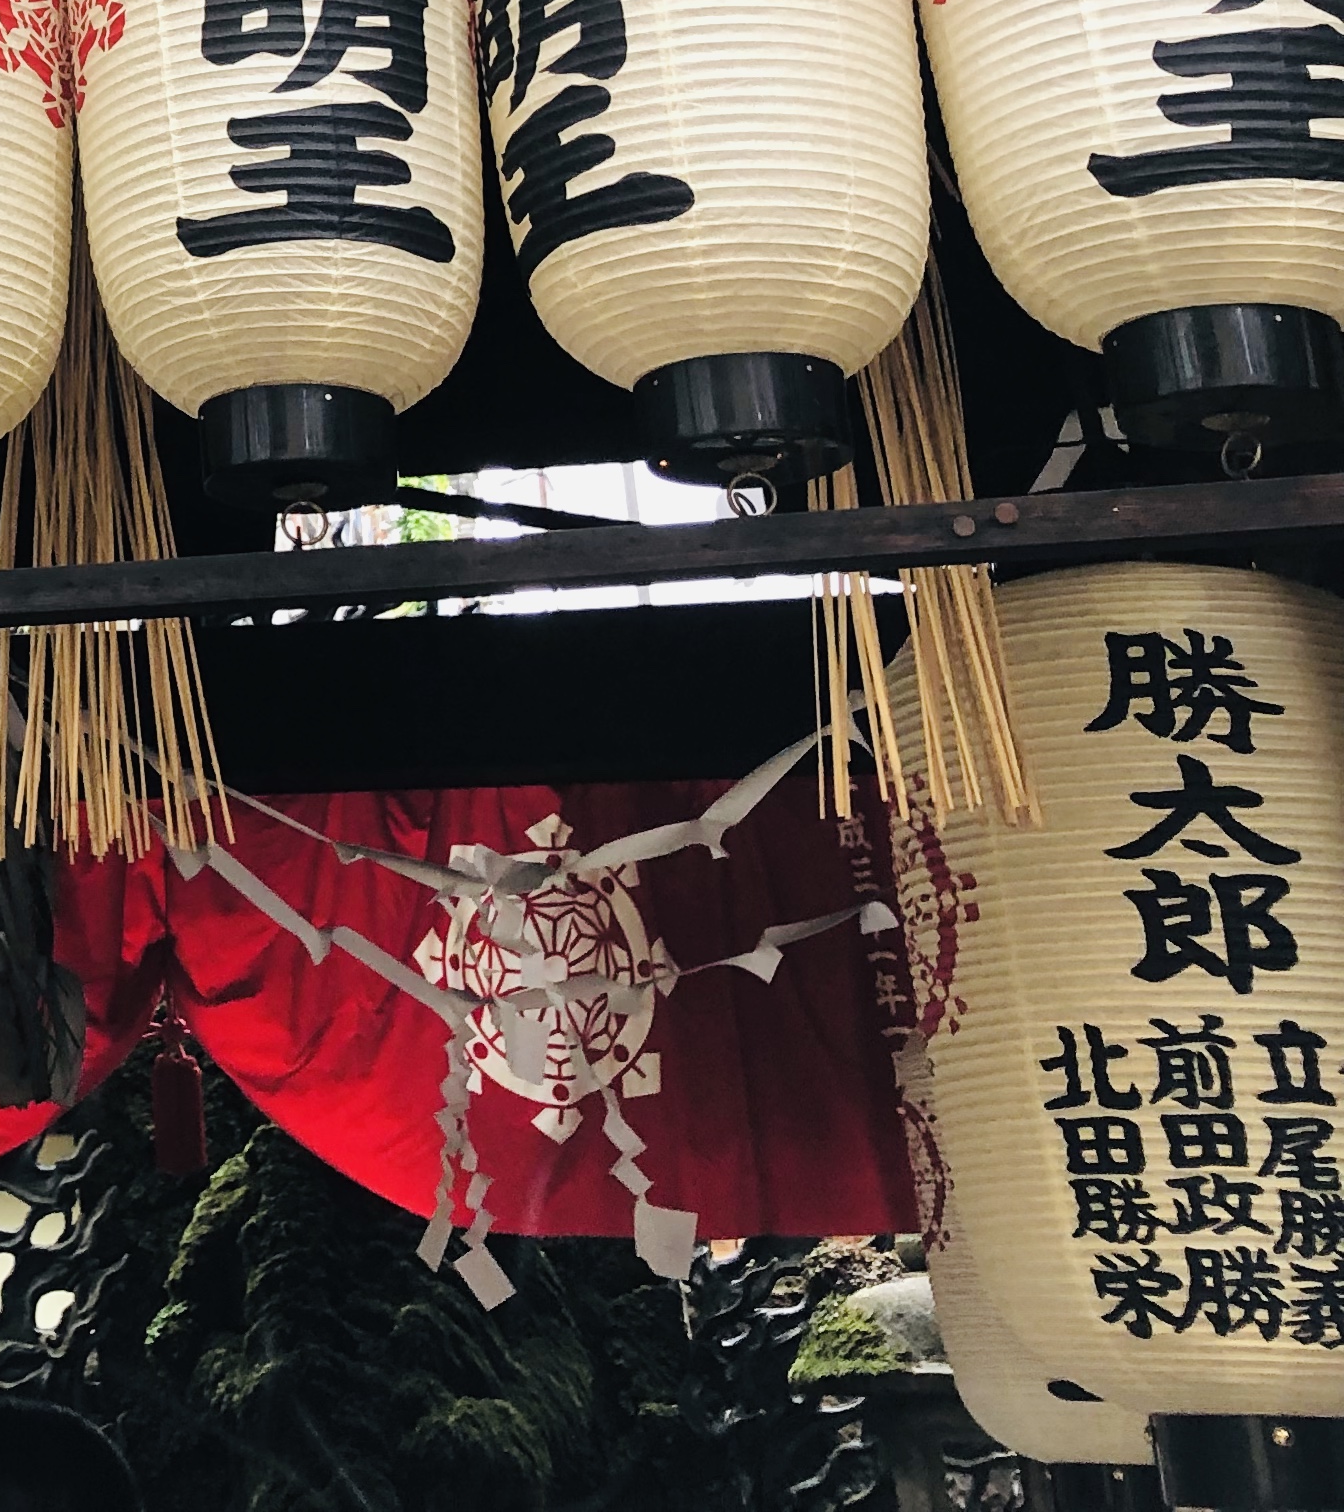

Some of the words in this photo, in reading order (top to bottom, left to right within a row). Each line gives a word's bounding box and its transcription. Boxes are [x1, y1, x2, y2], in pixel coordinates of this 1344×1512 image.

[1083, 628, 1302, 995] 勝太郎
[1039, 1022, 1183, 1340] 北田勝栄
[1137, 1014, 1290, 1342] 前田政勝
